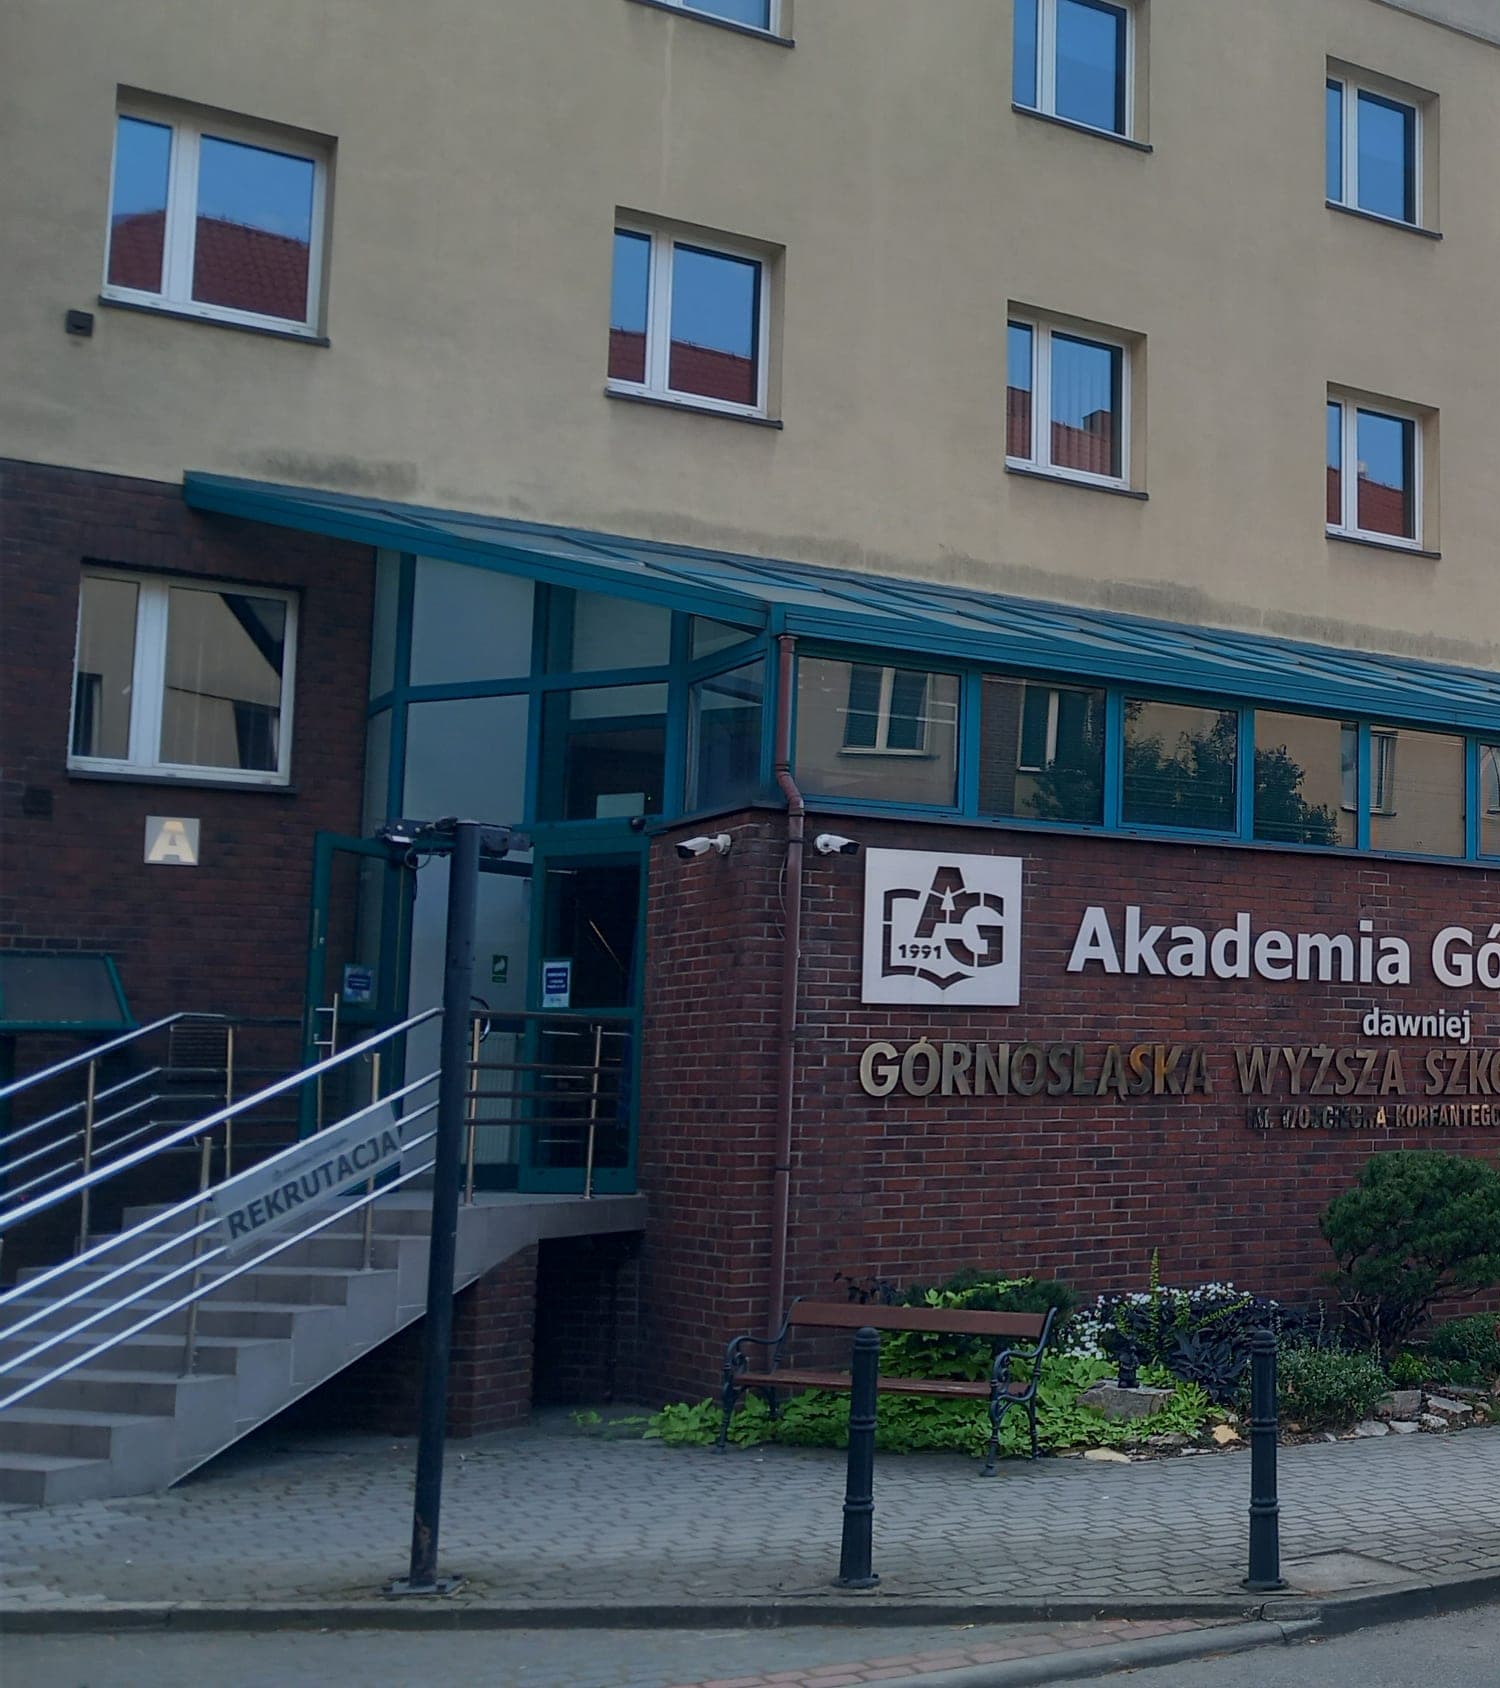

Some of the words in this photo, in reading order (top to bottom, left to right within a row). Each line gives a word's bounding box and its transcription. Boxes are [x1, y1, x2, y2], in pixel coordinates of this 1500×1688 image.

[149, 820, 195, 863] A
[898, 943, 942, 960] 1991
[1066, 904, 1412, 986] Akademia
[1362, 1006, 1471, 1044] dawniej
[1234, 1044, 1406, 1096] WYŻSZA
[226, 1130, 398, 1240] REKRUTACJA
